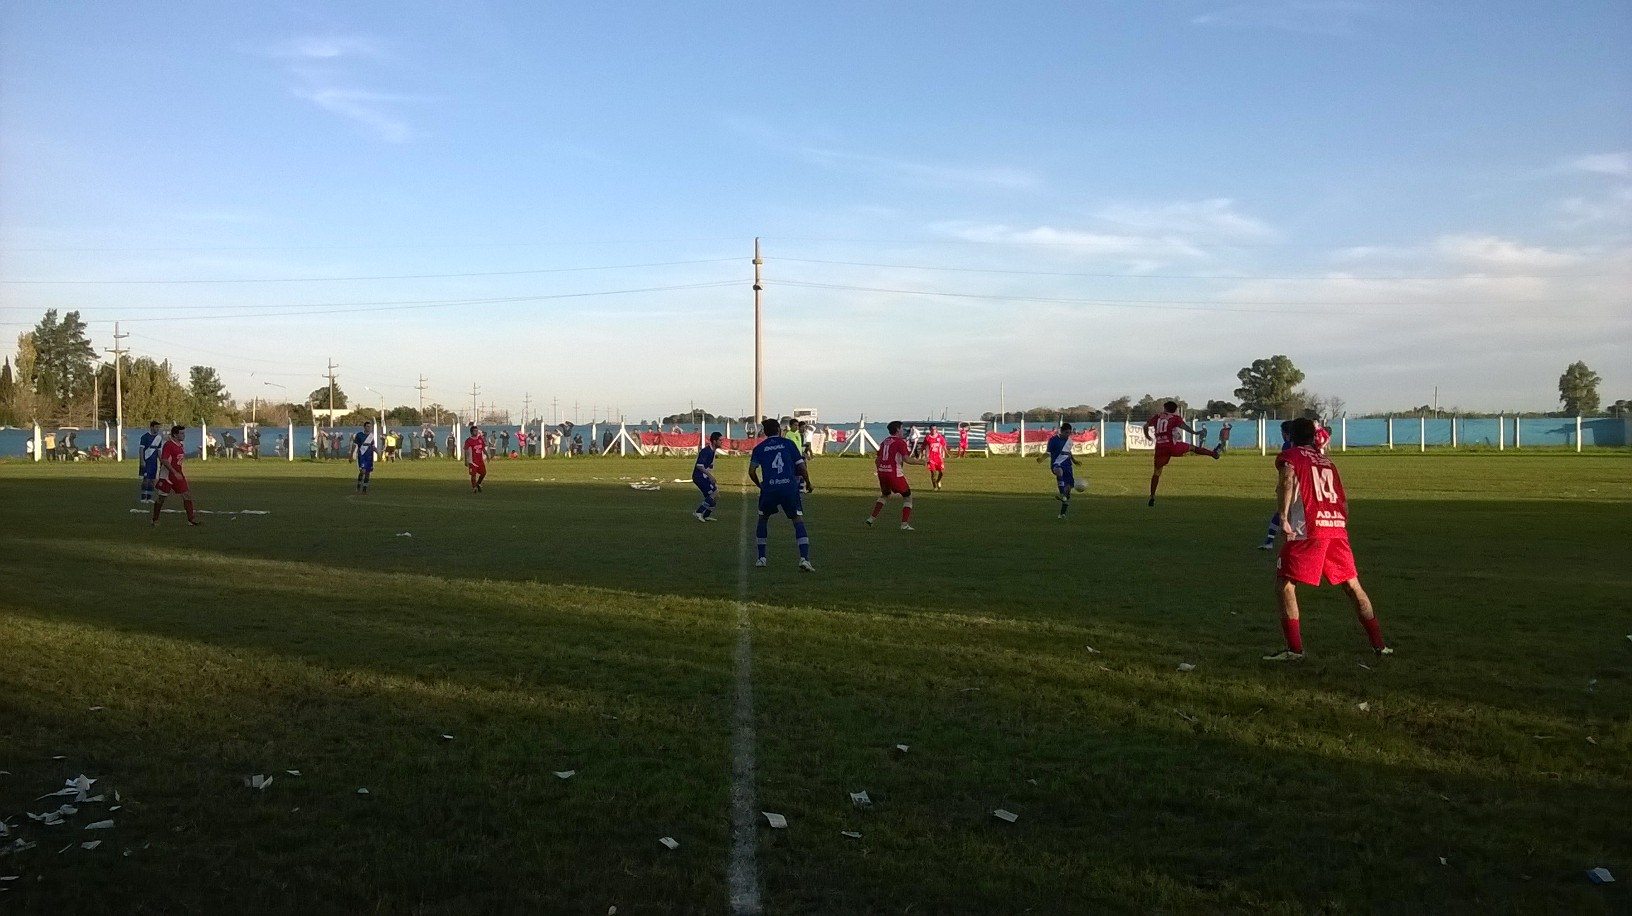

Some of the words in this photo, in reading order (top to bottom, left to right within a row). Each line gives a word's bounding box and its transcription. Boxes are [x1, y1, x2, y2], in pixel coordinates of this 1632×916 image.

[1156, 418, 1169, 433] 10
[882, 444, 890, 461] 11
[771, 452, 785, 475] 4
[1311, 465, 1338, 504] 14
